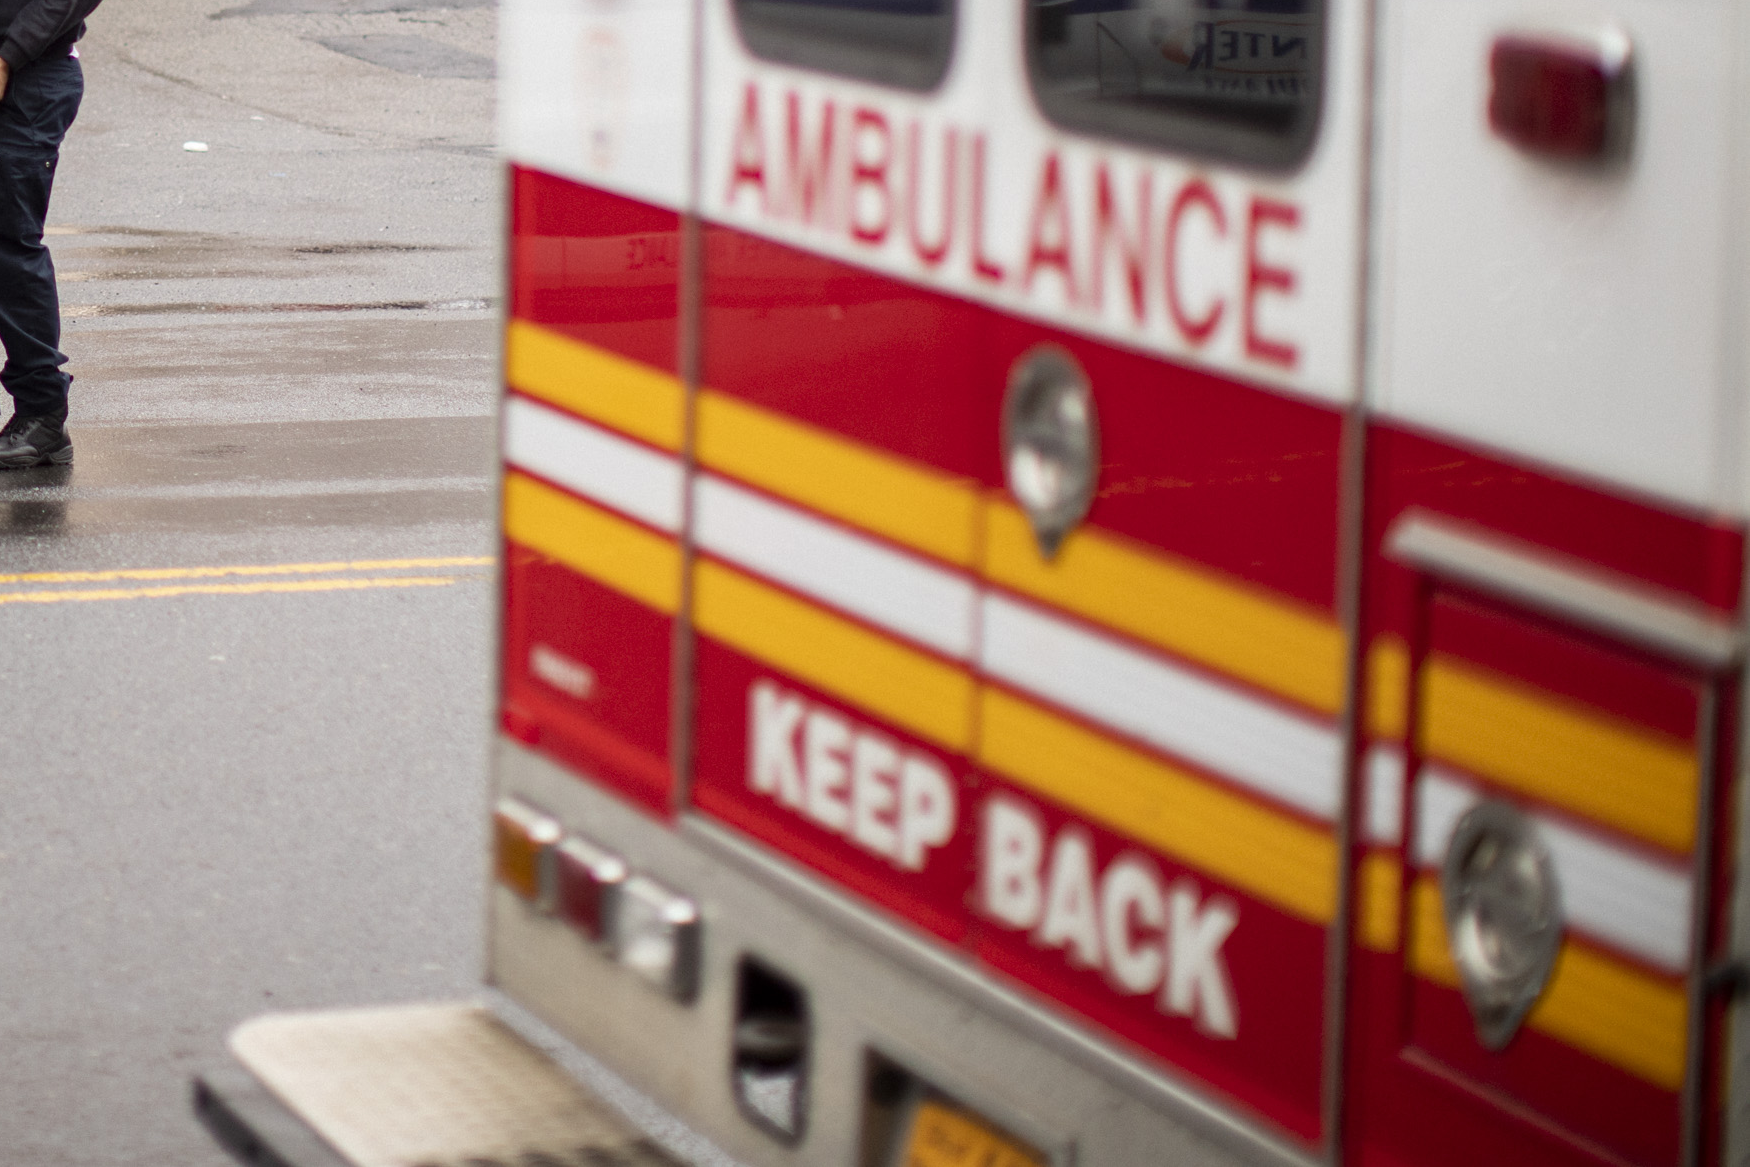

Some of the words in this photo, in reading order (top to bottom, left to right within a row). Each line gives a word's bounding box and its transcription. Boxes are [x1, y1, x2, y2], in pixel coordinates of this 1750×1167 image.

[726, 81, 1301, 370] AMBULANCE
[748, 682, 956, 872] KEEP
[982, 796, 1240, 1040] BACK
